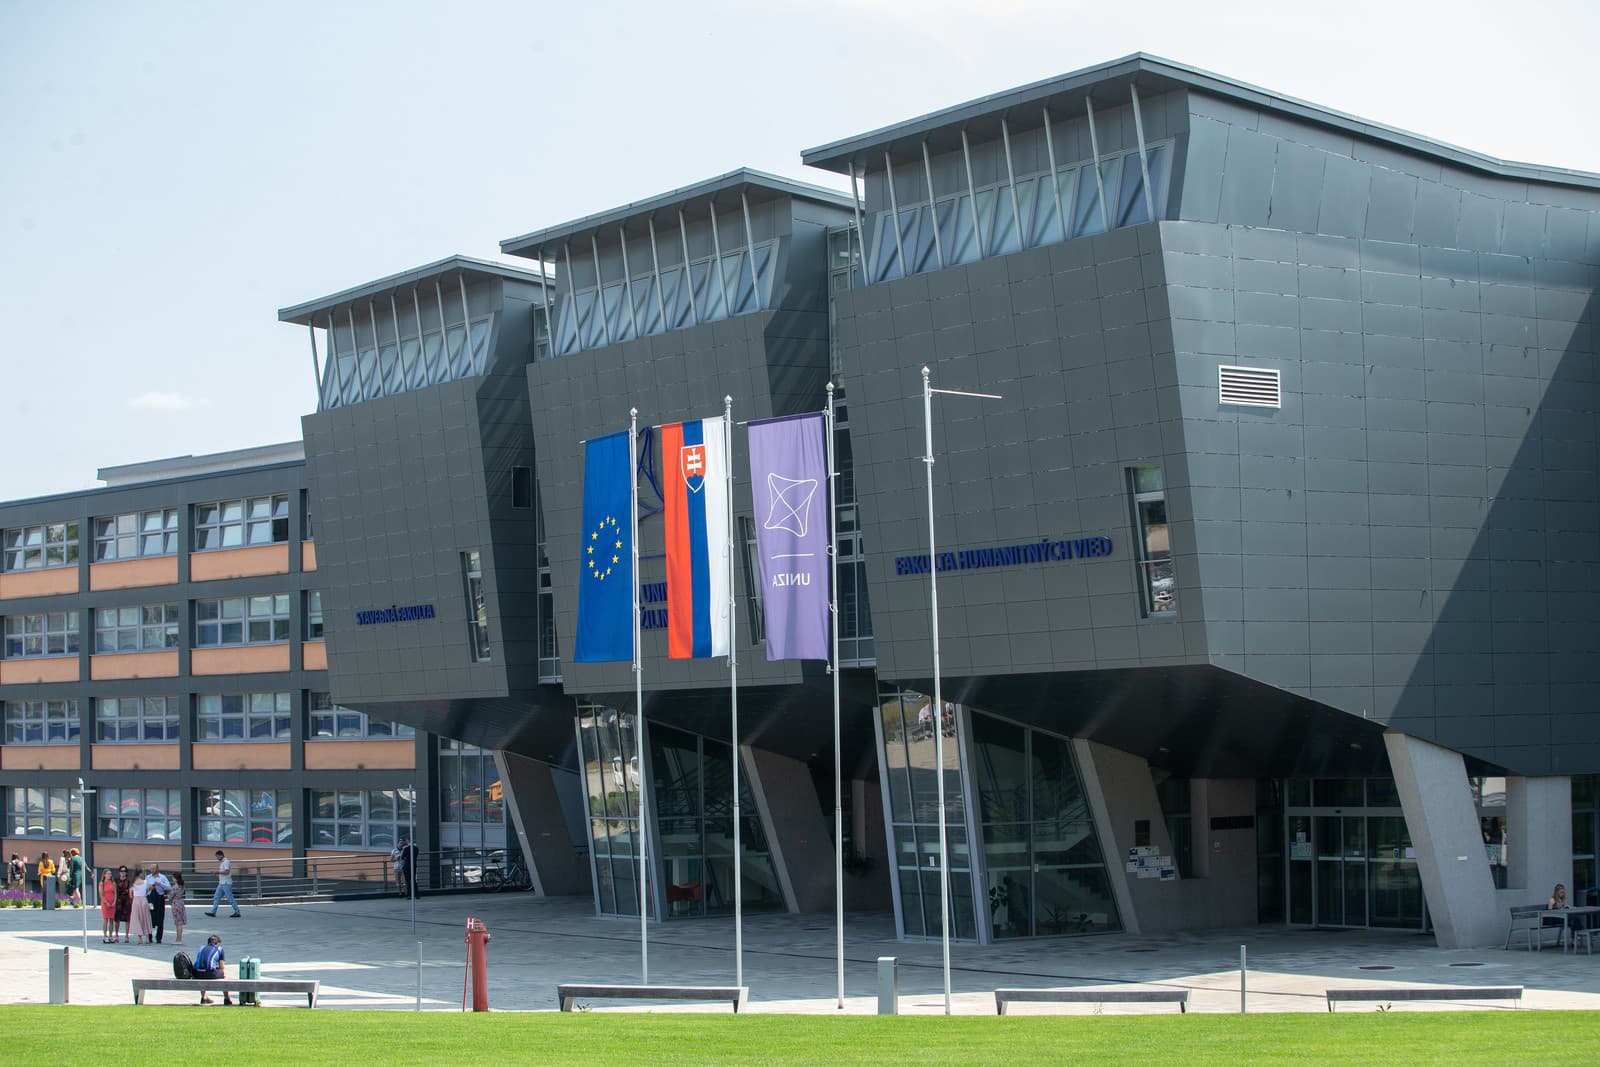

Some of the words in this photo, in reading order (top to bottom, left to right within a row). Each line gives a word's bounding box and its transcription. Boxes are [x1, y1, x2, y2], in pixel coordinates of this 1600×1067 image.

[959, 539, 1072, 569] HUMANITNÝCH
[1073, 536, 1113, 560] VIED
[398, 604, 436, 622] FAKULTA
[467, 917, 474, 929] H
